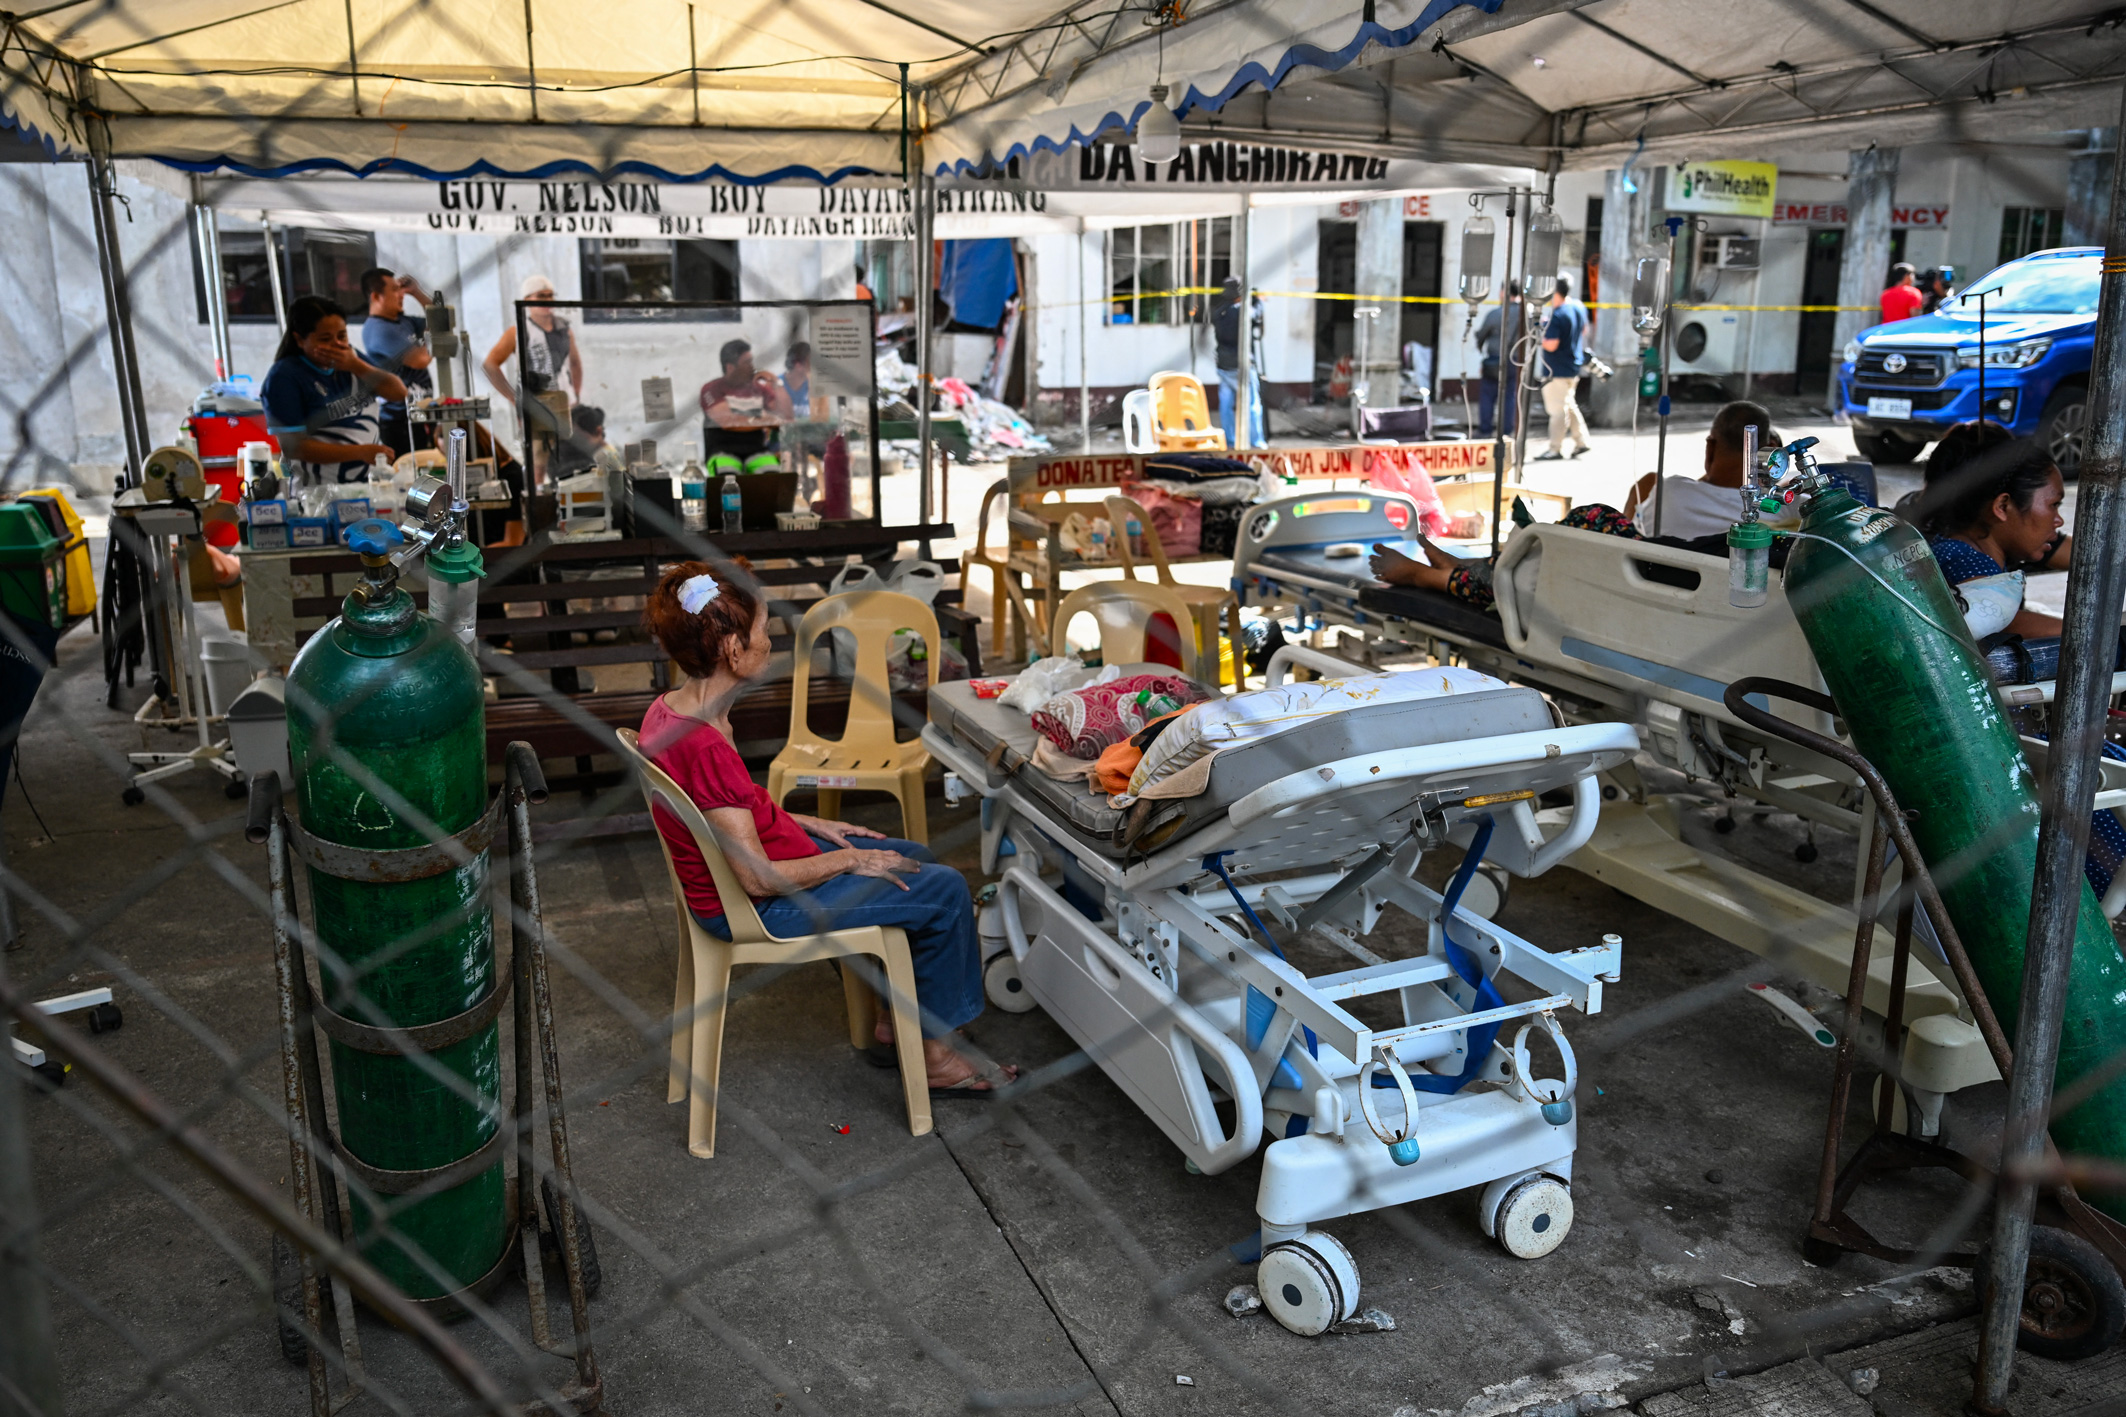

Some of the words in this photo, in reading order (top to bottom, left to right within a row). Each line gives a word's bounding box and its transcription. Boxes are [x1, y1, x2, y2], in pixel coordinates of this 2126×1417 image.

[539, 182, 662, 213] NELSON
[819, 187, 1047, 213] DAYANHIRANG
[1773, 204, 1948, 224] EMERNCY
[1363, 446, 1488, 473] DANGHIRANG
